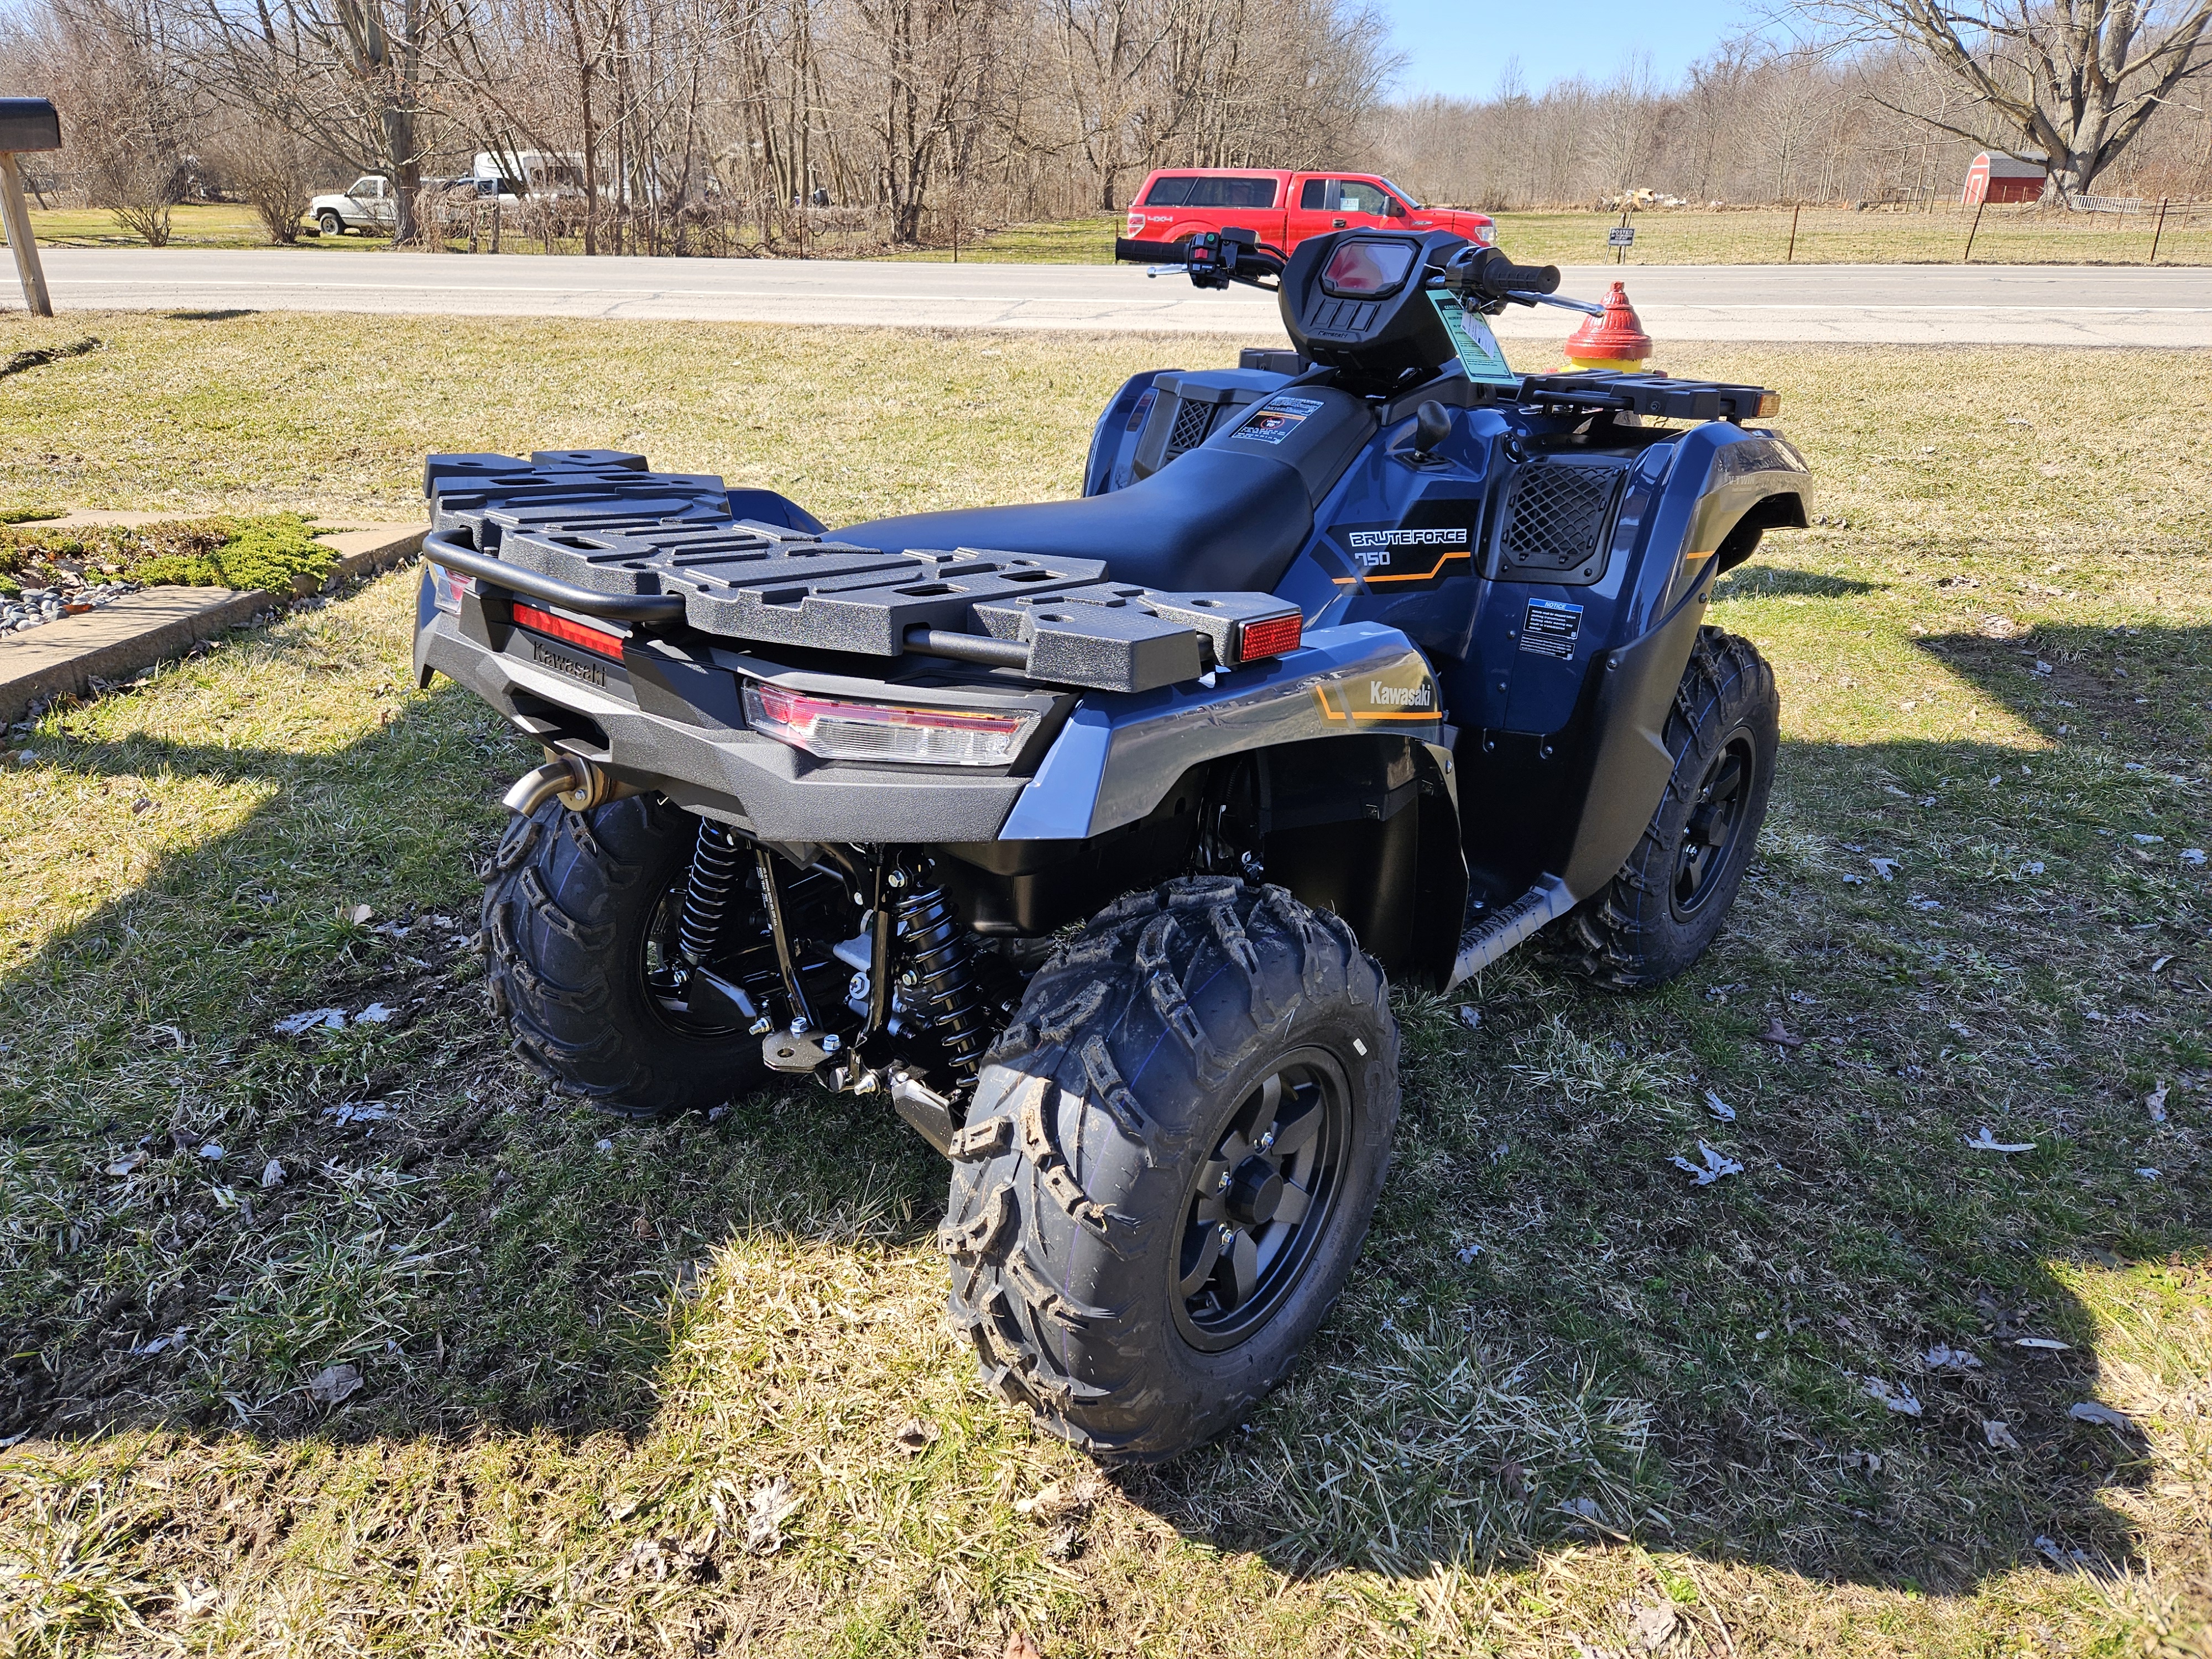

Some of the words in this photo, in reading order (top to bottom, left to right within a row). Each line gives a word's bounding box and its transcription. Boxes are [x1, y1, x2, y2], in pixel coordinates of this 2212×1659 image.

[1318, 330, 1348, 338] Kawasaki
[1728, 475, 1755, 485] V-TWIN
[1354, 551, 1391, 566] 750
[1544, 602, 1567, 610] NOTICE
[533, 640, 607, 689] Kawasaki
[1370, 680, 1431, 707] Kawasaki
